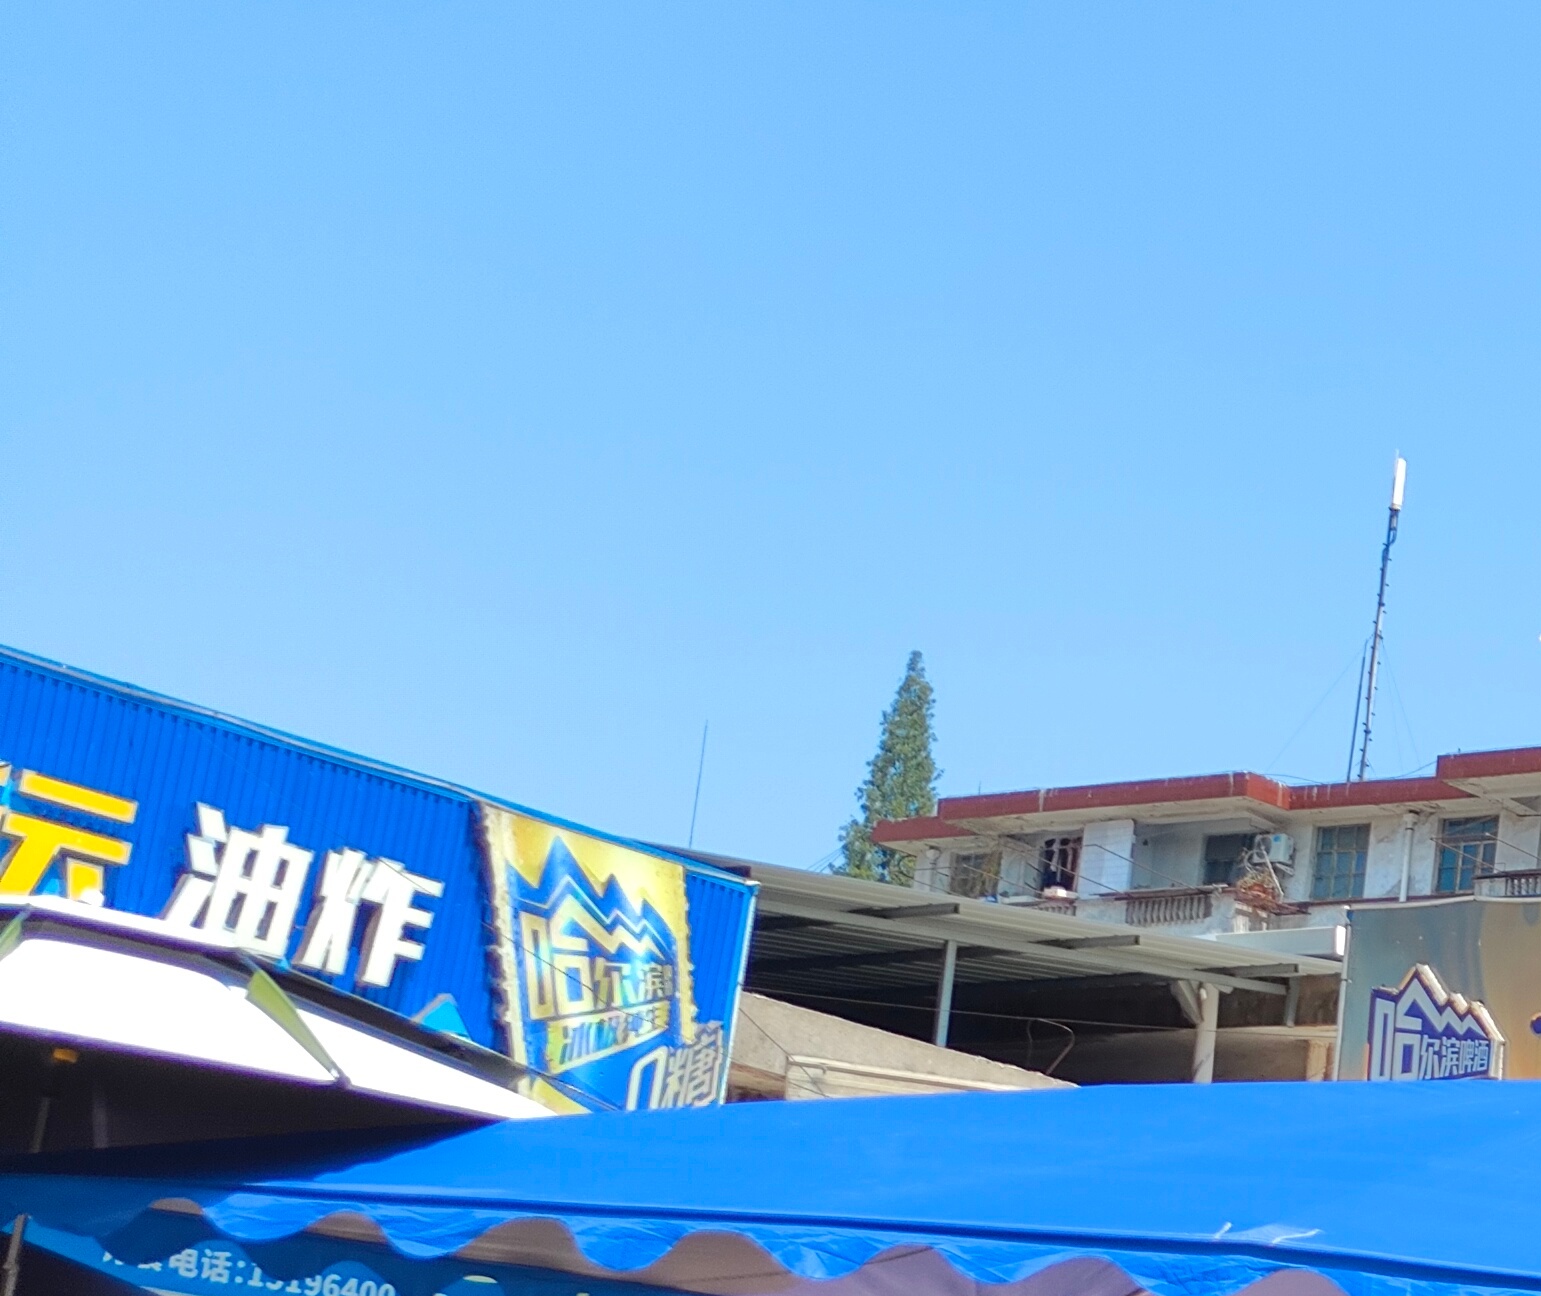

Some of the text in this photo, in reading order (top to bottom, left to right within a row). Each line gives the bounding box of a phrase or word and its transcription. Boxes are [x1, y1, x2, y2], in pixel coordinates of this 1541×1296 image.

[163, 802, 445, 987] 油炸
[1374, 977, 1491, 1080] 哈尔滨啤酒
